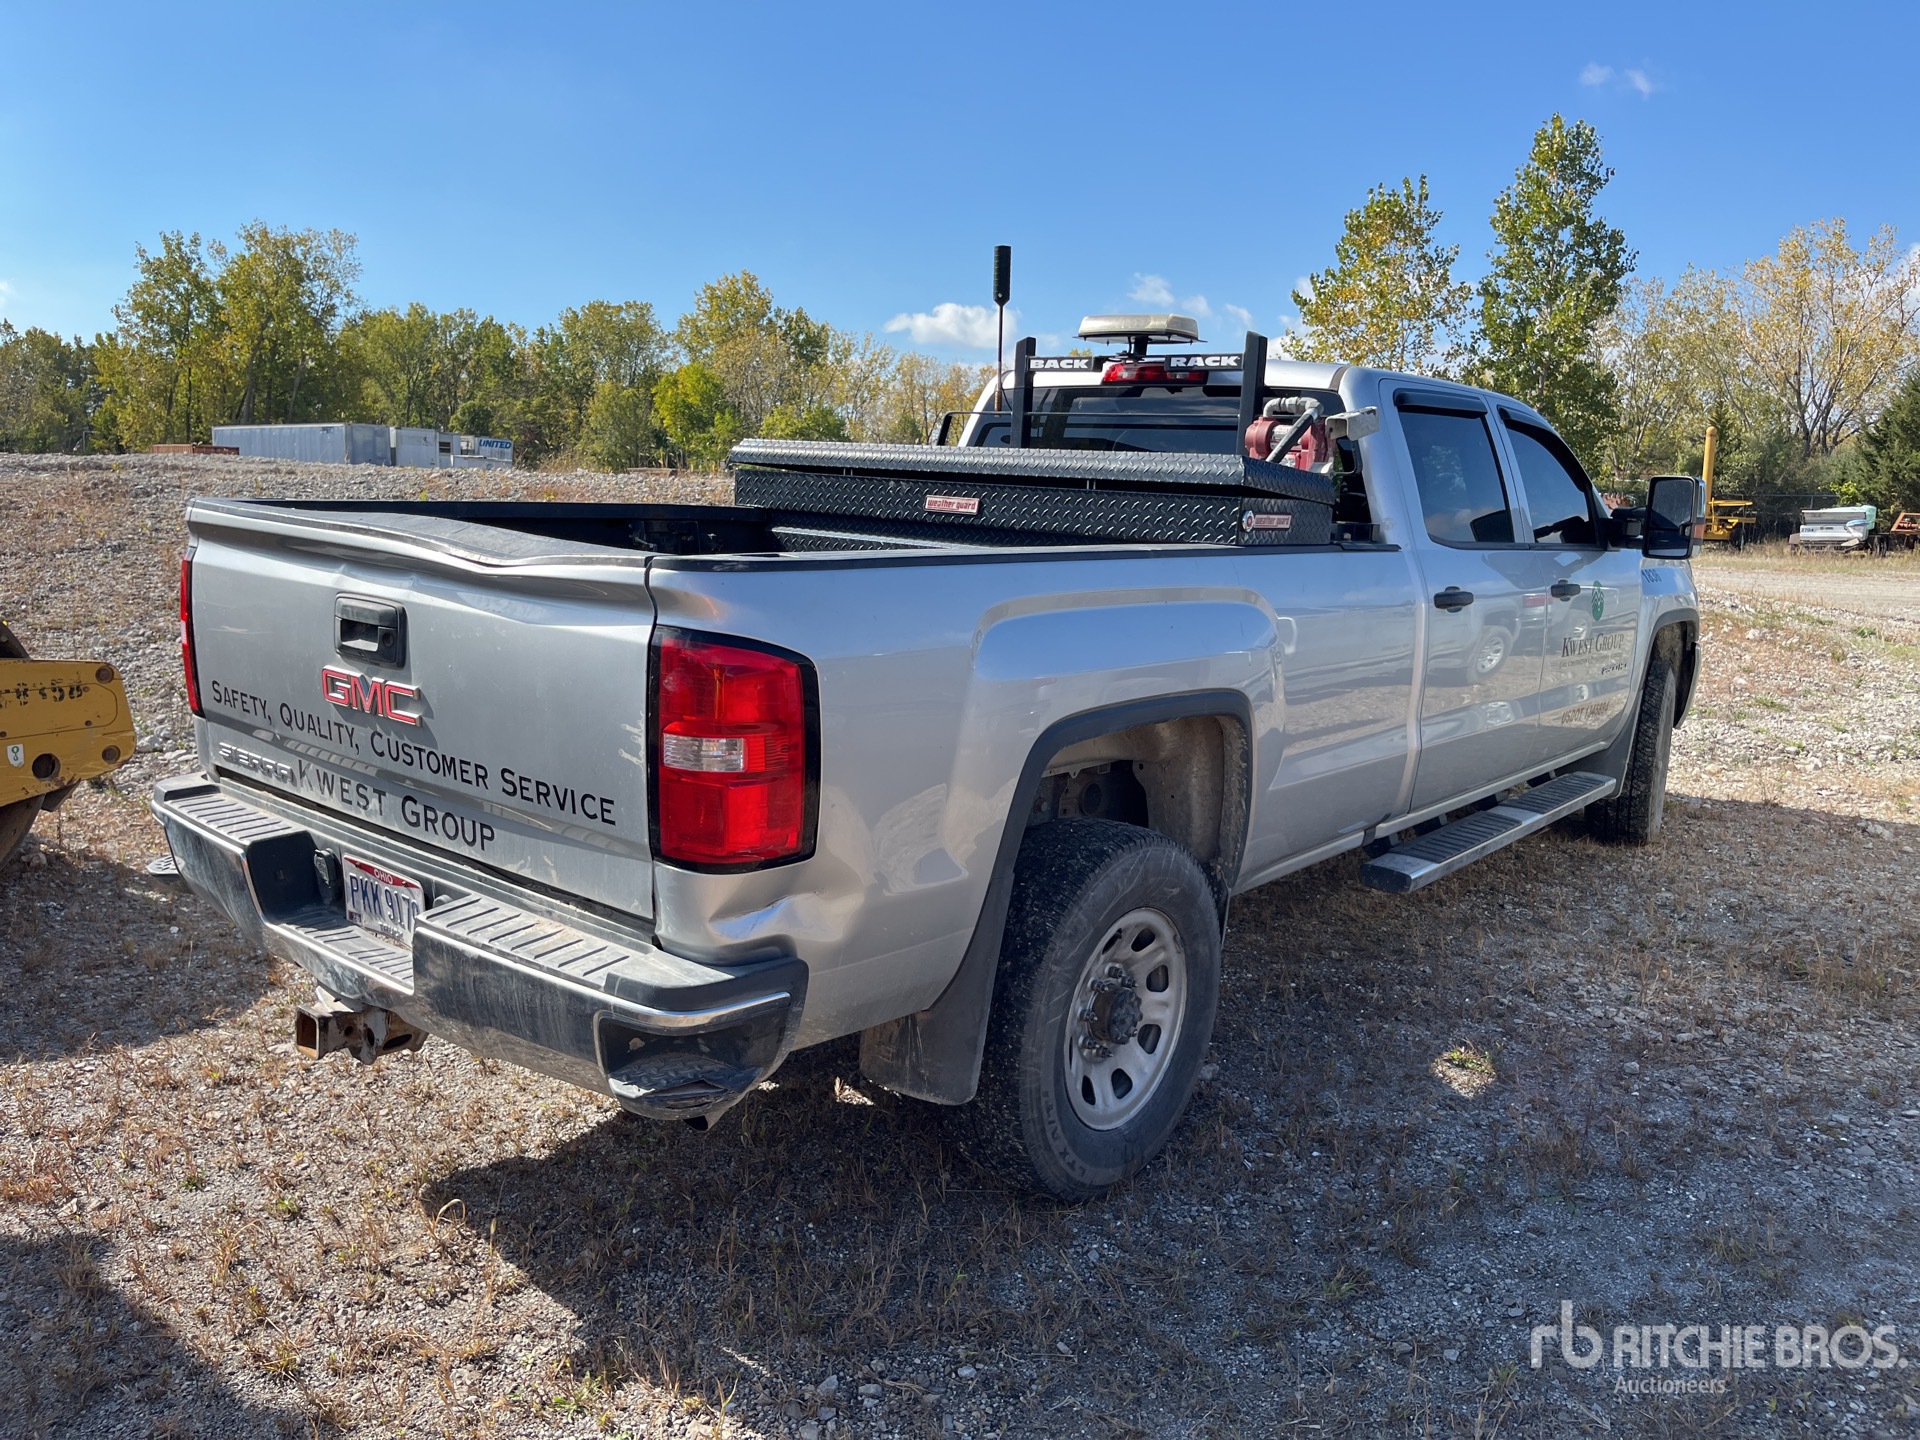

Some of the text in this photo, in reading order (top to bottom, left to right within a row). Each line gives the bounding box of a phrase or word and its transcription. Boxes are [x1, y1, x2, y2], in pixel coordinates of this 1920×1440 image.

[1030, 356, 1239, 369] BACK RACK
[479, 439, 512, 449] UNITED
[1561, 633, 1625, 657] KWEST GROUP
[321, 664, 423, 727] GMC
[219, 742, 292, 785] SIERRA
[370, 732, 489, 790] CUSTOMER
[499, 767, 617, 826] SERVICE
[400, 794, 496, 851] GROUP
[373, 868, 394, 885] OHIO
